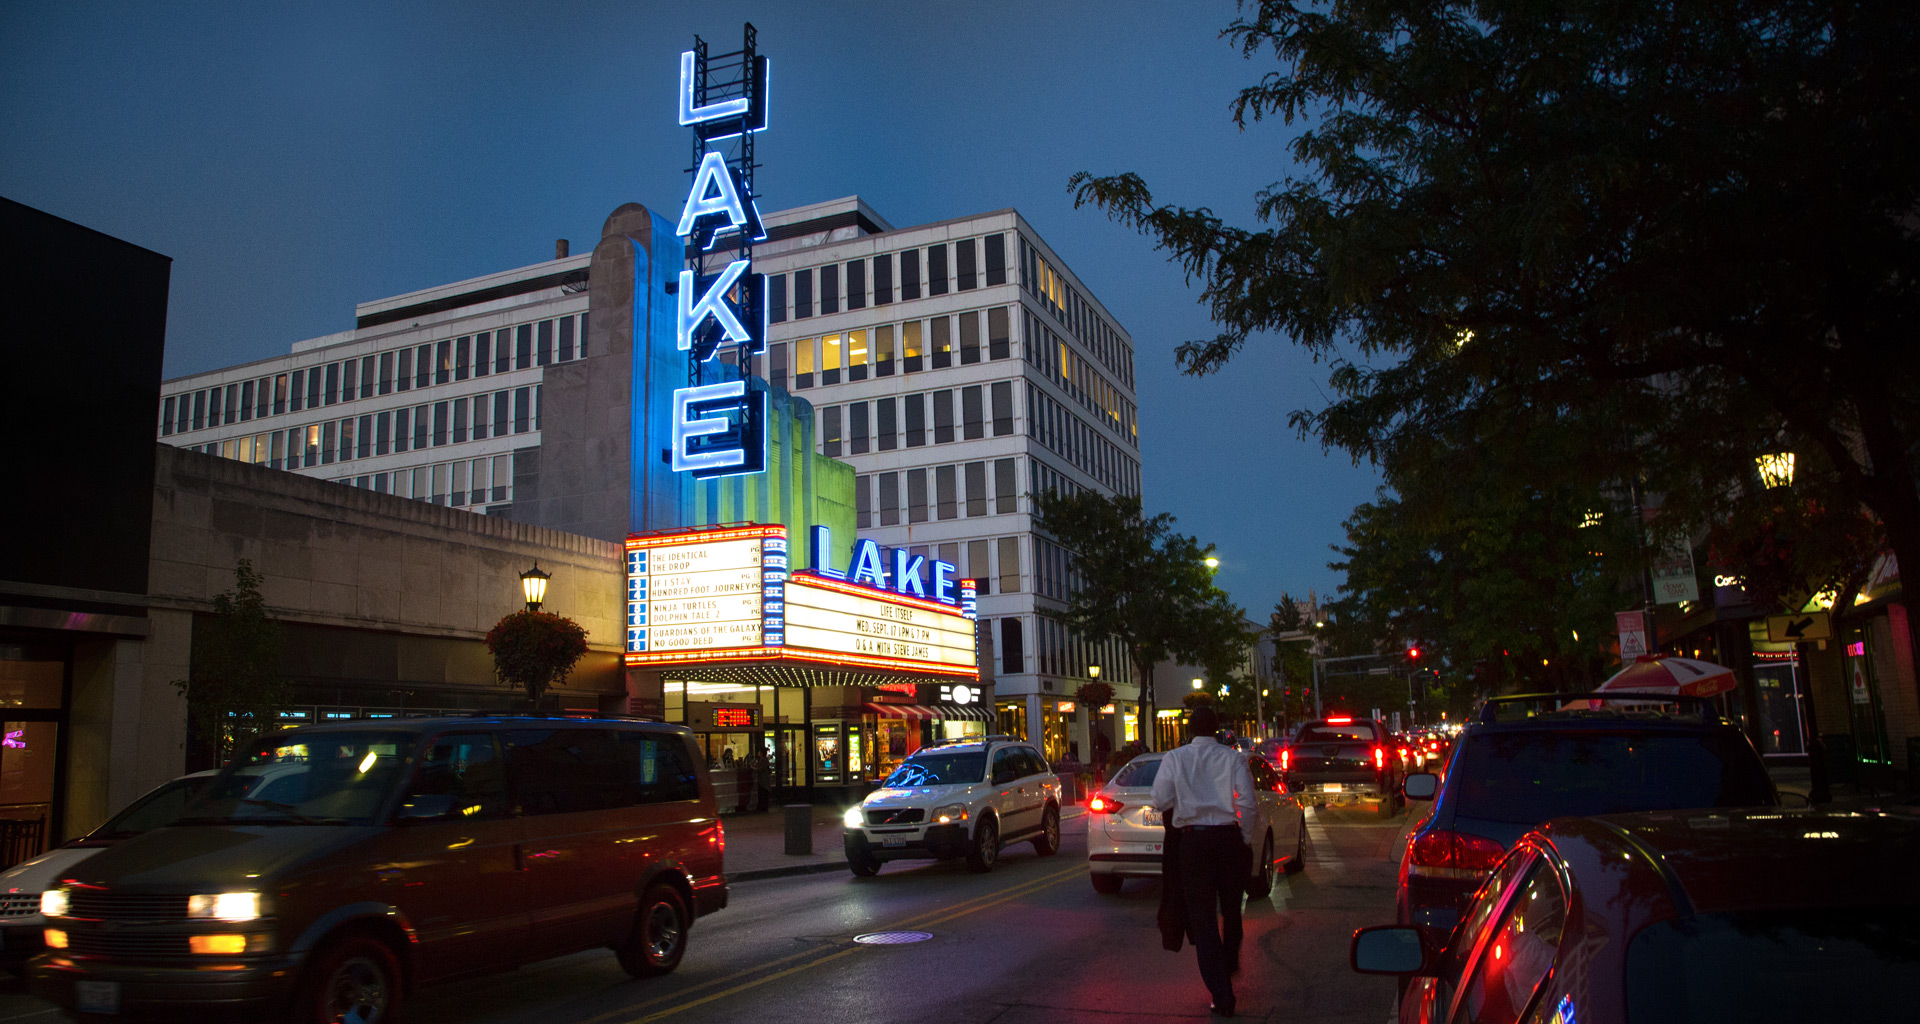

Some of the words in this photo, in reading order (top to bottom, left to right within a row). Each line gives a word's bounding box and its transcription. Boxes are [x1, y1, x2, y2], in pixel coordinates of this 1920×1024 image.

[672, 50, 751, 472] LAKE
[634, 553, 640, 562] 1
[652, 554, 665, 562] THE
[669, 551, 707, 560] IDENTICAL
[633, 563, 641, 573] 2
[653, 564, 666, 572] THE
[669, 562, 689, 570] DROP
[811, 525, 956, 605] LAKE
[633, 590, 641, 600] 4
[653, 588, 688, 597] HUNDRED
[691, 586, 709, 594] FOOT
[714, 583, 750, 592] JOURNEY
[634, 579, 641, 588] 3
[634, 604, 640, 613] 5
[654, 604, 677, 612] NINJA
[682, 601, 716, 610] TURTLES
[881, 605, 893, 617] LIFE
[895, 607, 913, 621] ITSELF
[634, 615, 640, 624] 6
[654, 613, 687, 622] DOLPHIN
[692, 611, 710, 619] TALE
[633, 631, 640, 639] 7
[654, 627, 697, 637] GUARDIANS
[714, 625, 727, 633] THE
[730, 623, 761, 633] GALAXY
[856, 620, 871, 632] WED.
[873, 623, 889, 635] SEPT.
[891, 626, 896, 636] 17
[911, 629, 915, 639] &
[916, 629, 920, 639] 7
[922, 630, 930, 640] PM
[633, 641, 640, 650] 8
[655, 639, 665, 647] NO
[669, 638, 689, 646] GOOD
[694, 637, 713, 645] DEED
[856, 639, 860, 650] Q
[862, 640, 867, 650] &
[869, 641, 873, 651] A
[877, 641, 891, 654] WITH
[894, 644, 910, 656] STEVE
[911, 646, 928, 658] JAMES
